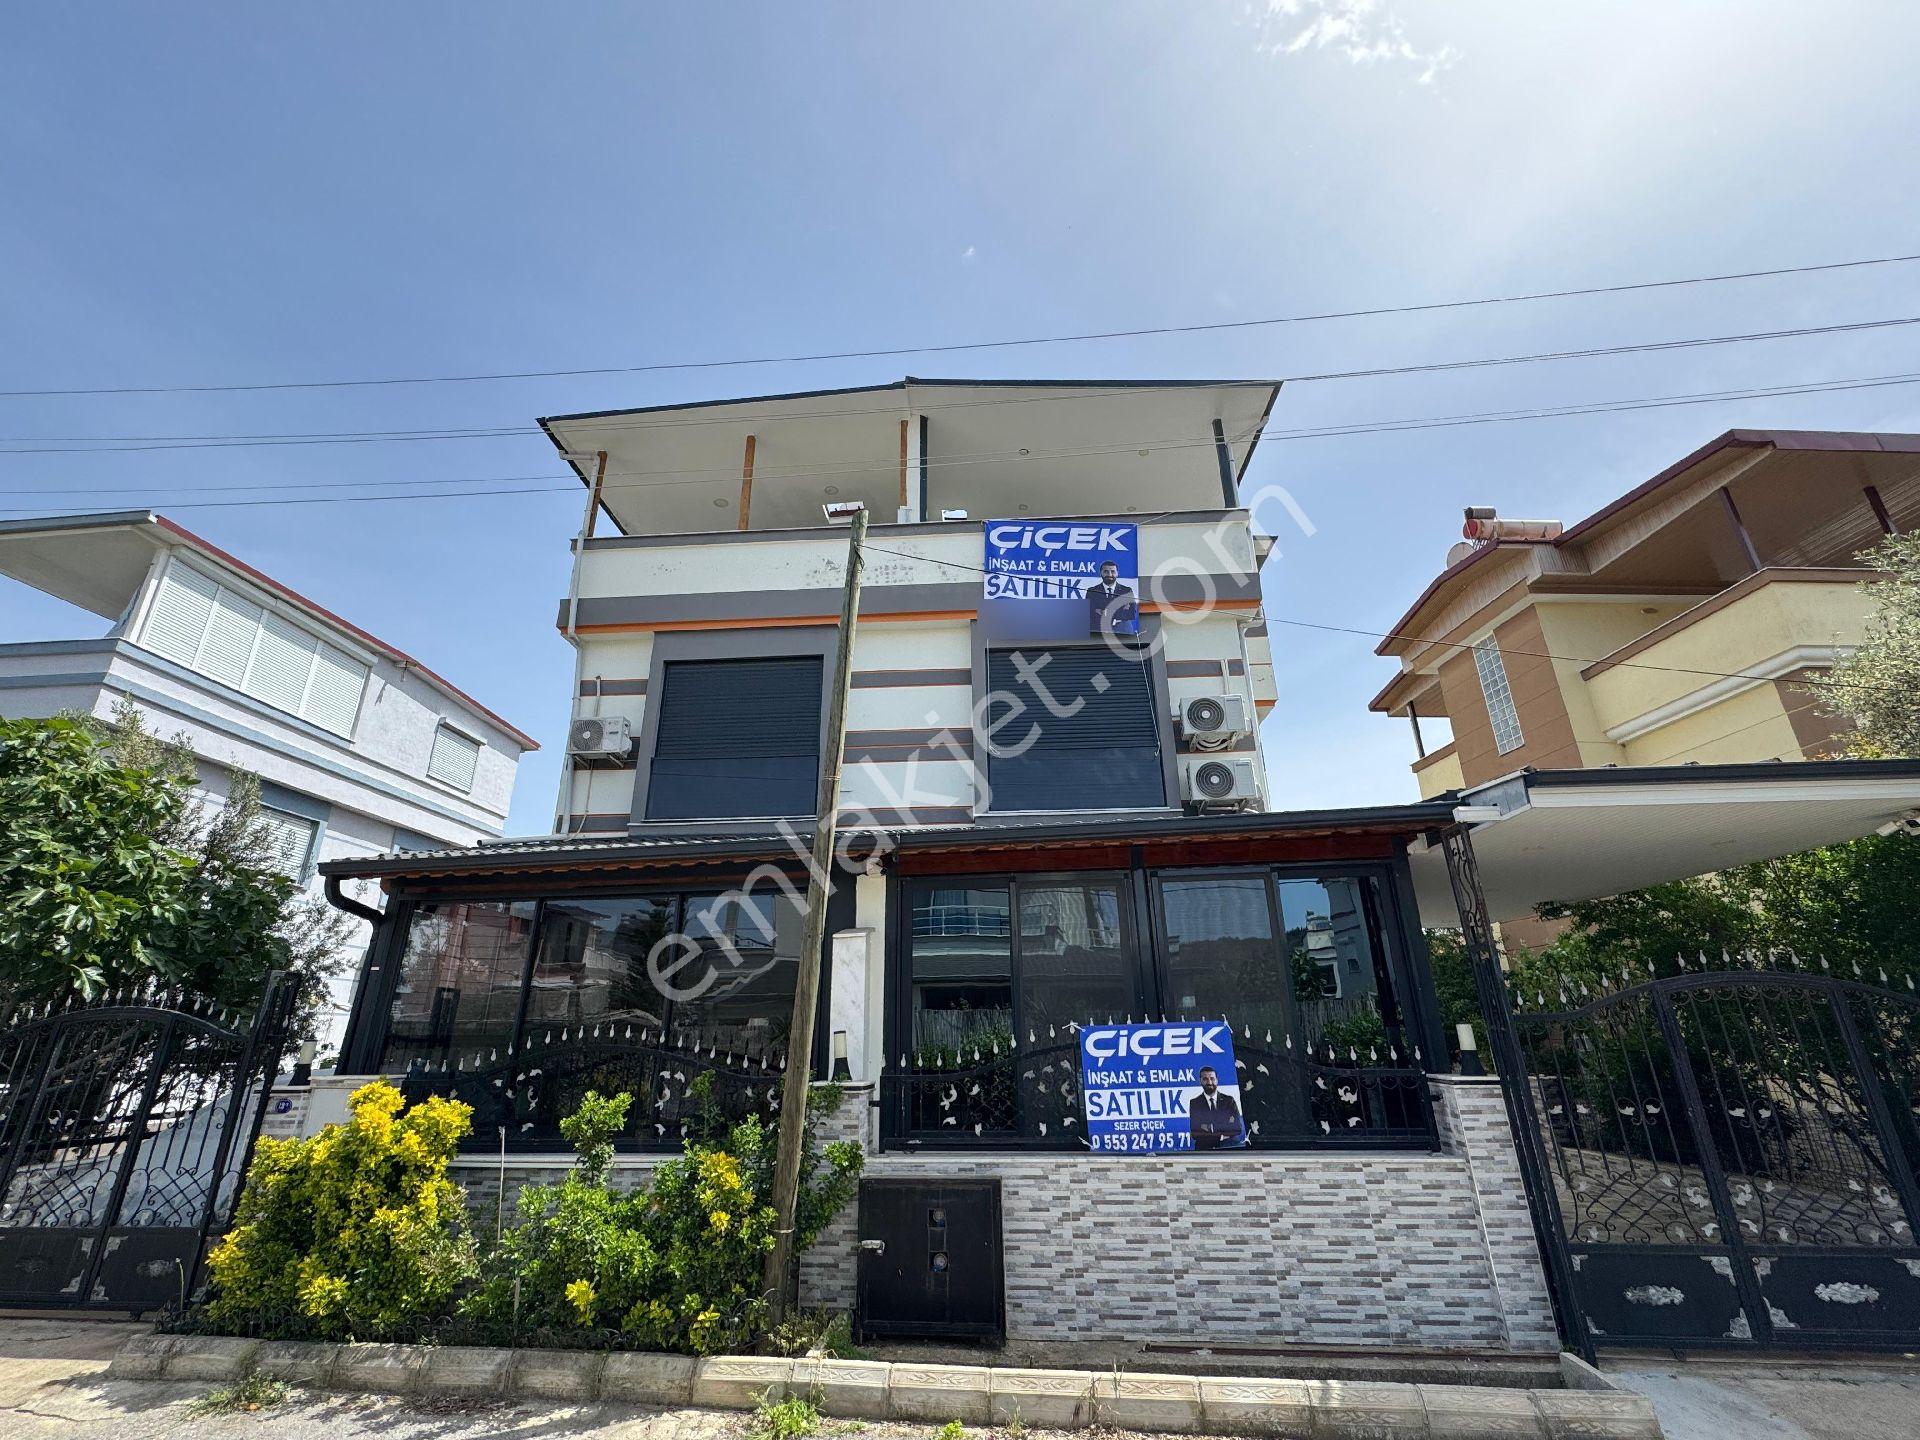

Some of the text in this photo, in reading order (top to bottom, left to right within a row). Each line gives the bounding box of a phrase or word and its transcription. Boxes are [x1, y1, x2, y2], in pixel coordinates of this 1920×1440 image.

[988, 556, 1096, 573] İNŞAAT & EMLAK
[986, 575, 1086, 600] SATILIK
[1087, 1068, 1196, 1088] İNŞAAT & EMLAK
[1088, 1089, 1188, 1118] SATILIK
[1114, 1119, 1166, 1131] SEZER ÇİÇEK
[1092, 1132, 1191, 1151] 0 553 247 95 71
